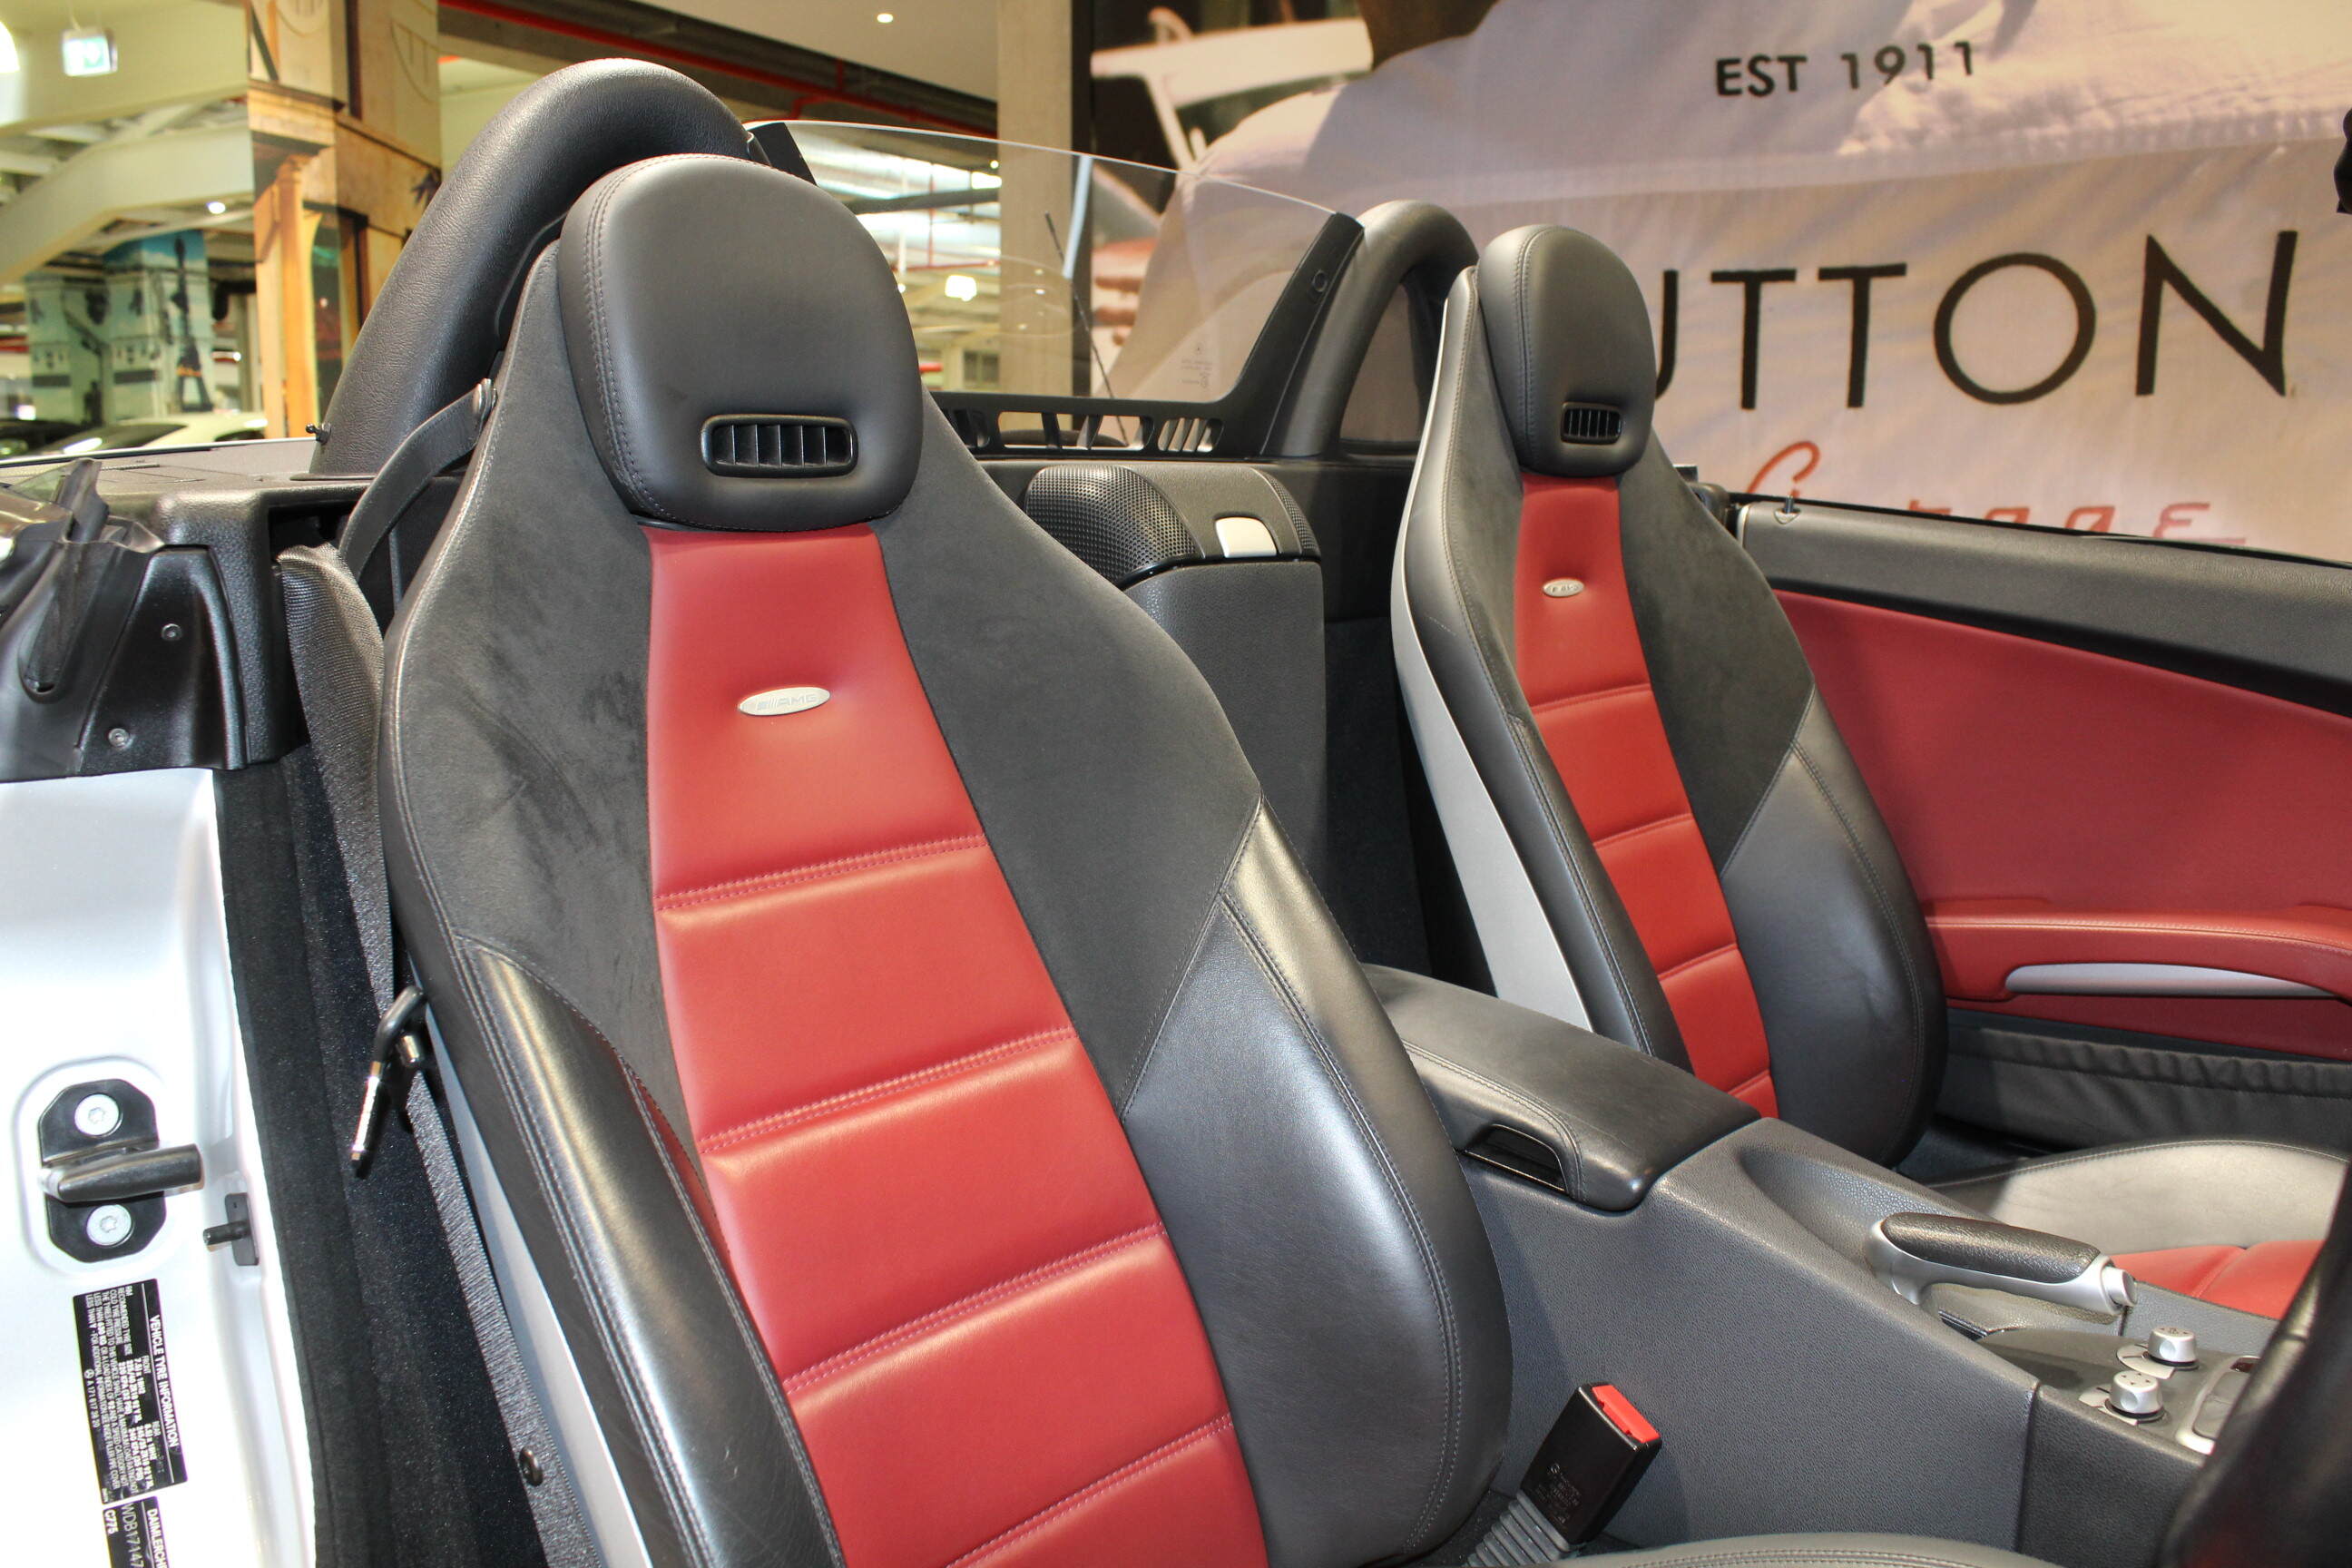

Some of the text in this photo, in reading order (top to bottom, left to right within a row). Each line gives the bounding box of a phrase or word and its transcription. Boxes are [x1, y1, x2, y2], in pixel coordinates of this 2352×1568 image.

[1716, 41, 1975, 98] EST 1911
[150, 1315, 164, 1355] VEHICLE
[155, 1356, 168, 1380] TYRE
[159, 1381, 179, 1447] INFORMATION
